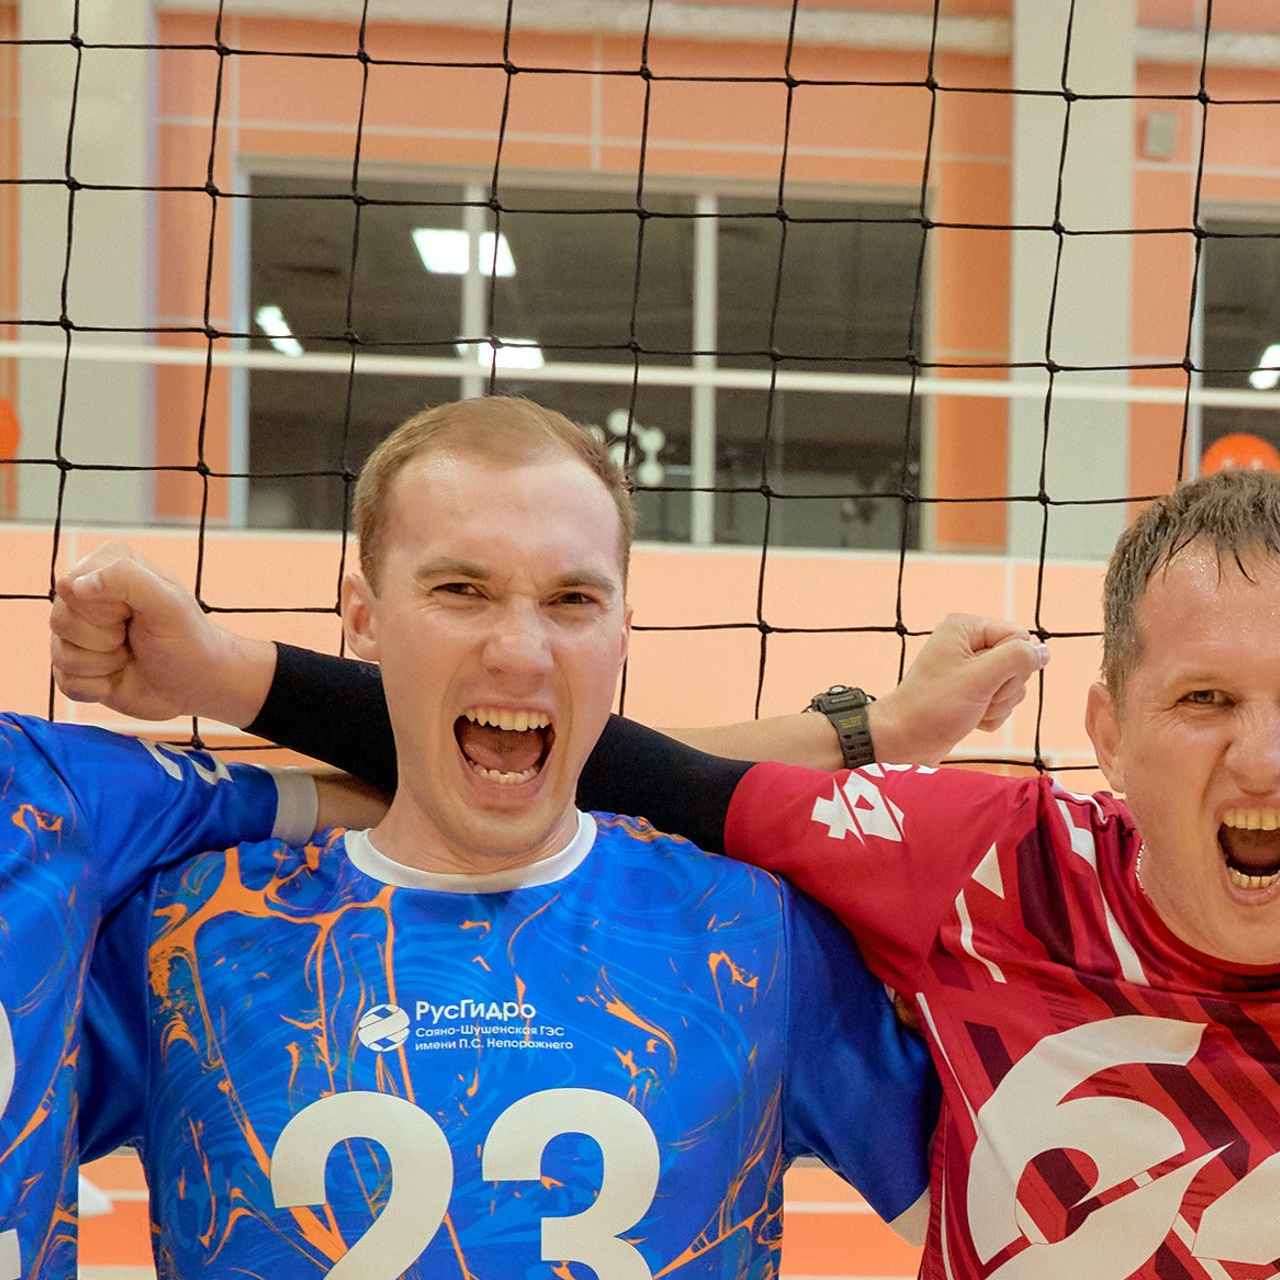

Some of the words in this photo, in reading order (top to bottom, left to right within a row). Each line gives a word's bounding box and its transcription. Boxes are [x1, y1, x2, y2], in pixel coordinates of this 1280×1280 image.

[415, 998, 537, 1024] РусГидро
[415, 1024, 538, 1038] Саяно-Шушенская
[540, 1025, 565, 1037] ГЭС
[415, 1040, 457, 1051] имени
[459, 1038, 484, 1049] П.С.
[487, 1037, 574, 1050] Непорожнего
